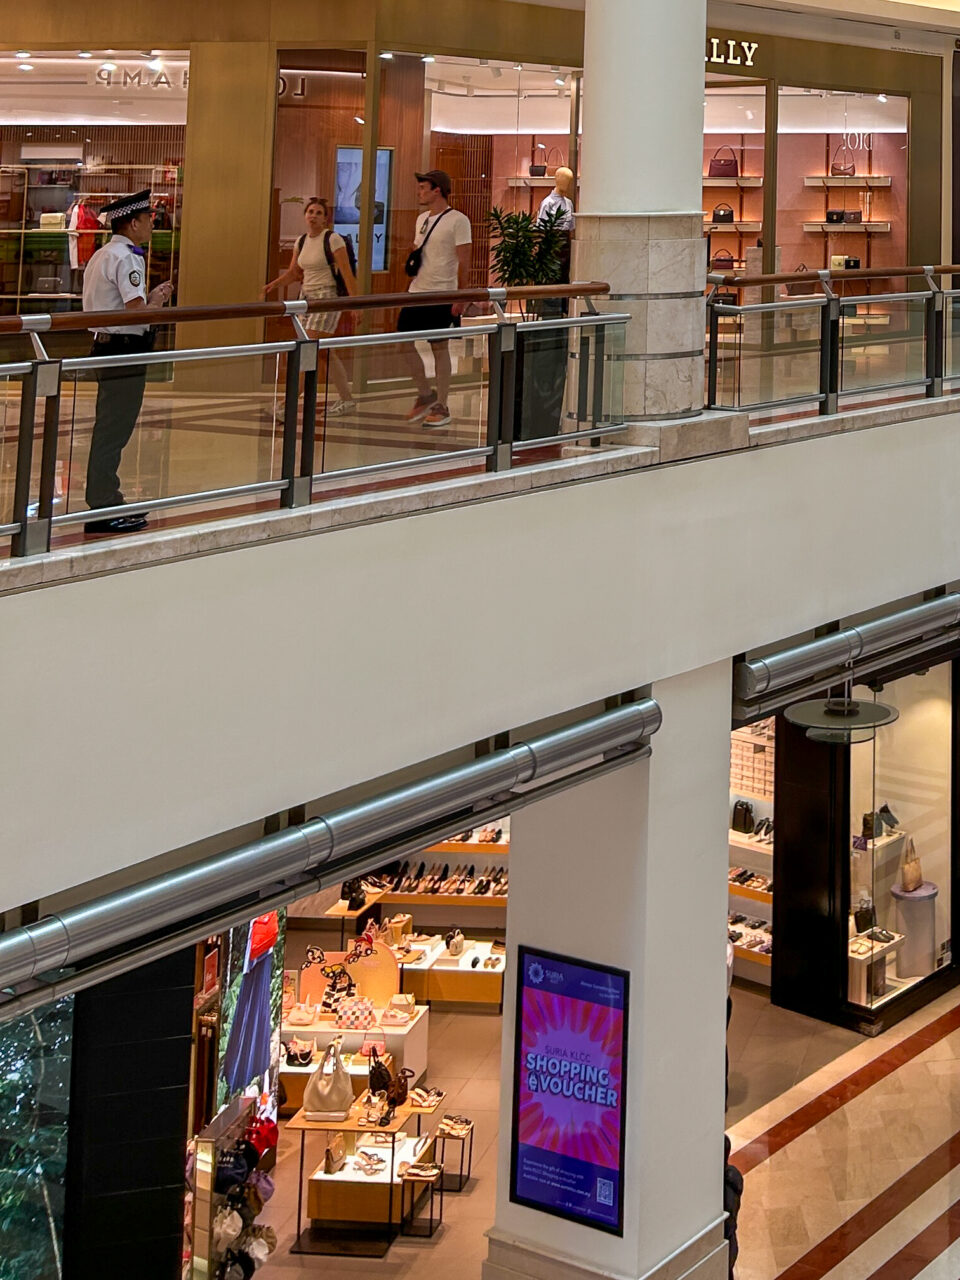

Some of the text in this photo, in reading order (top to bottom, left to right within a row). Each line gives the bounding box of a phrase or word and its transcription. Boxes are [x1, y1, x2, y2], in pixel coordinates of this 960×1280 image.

[705, 37, 759, 66] LLY
[545, 1045, 568, 1058] SURIA
[526, 1053, 609, 1086] SHOPPING
